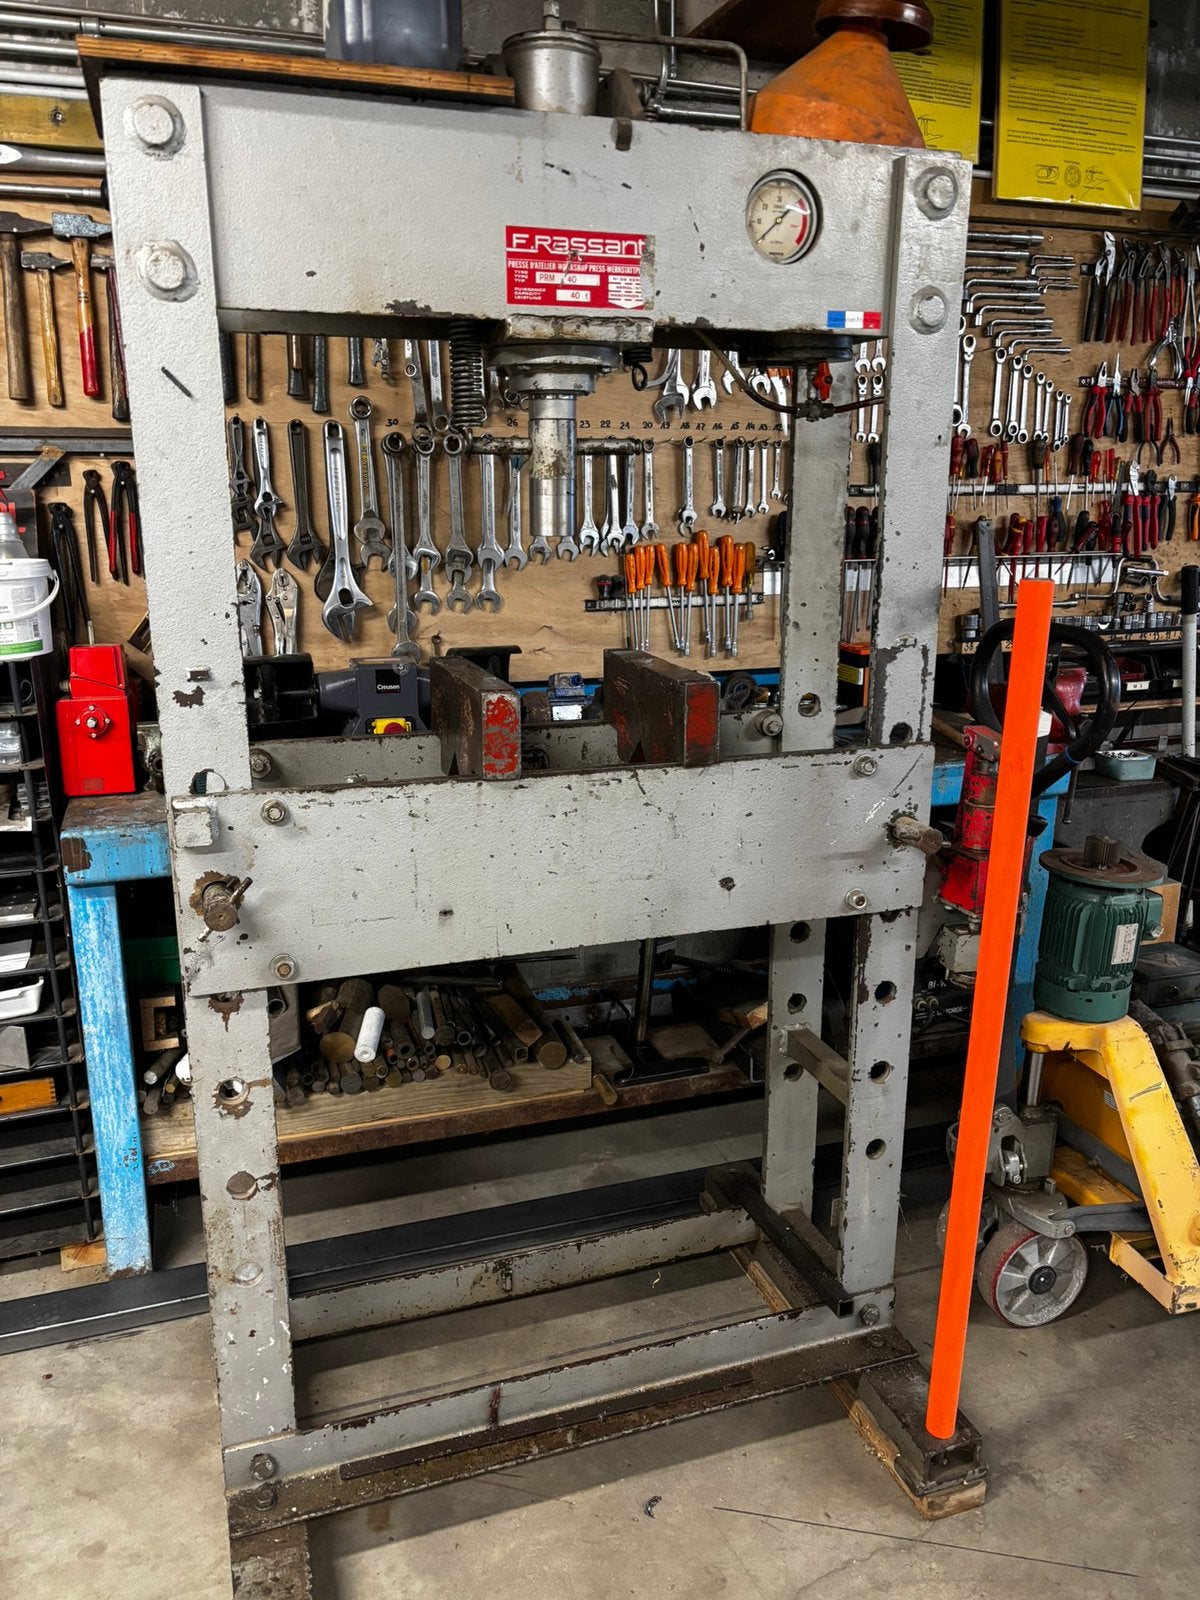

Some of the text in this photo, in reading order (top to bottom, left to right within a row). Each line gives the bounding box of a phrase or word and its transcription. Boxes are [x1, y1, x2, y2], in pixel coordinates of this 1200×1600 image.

[508, 260, 529, 269] PRESSE
[567, 275, 577, 283] 40
[570, 292, 580, 300] 40
[386, 418, 399, 427] 30
[506, 418, 518, 427] 26
[580, 420, 591, 429] 23
[600, 420, 611, 428] 22
[642, 421, 653, 429] 20
